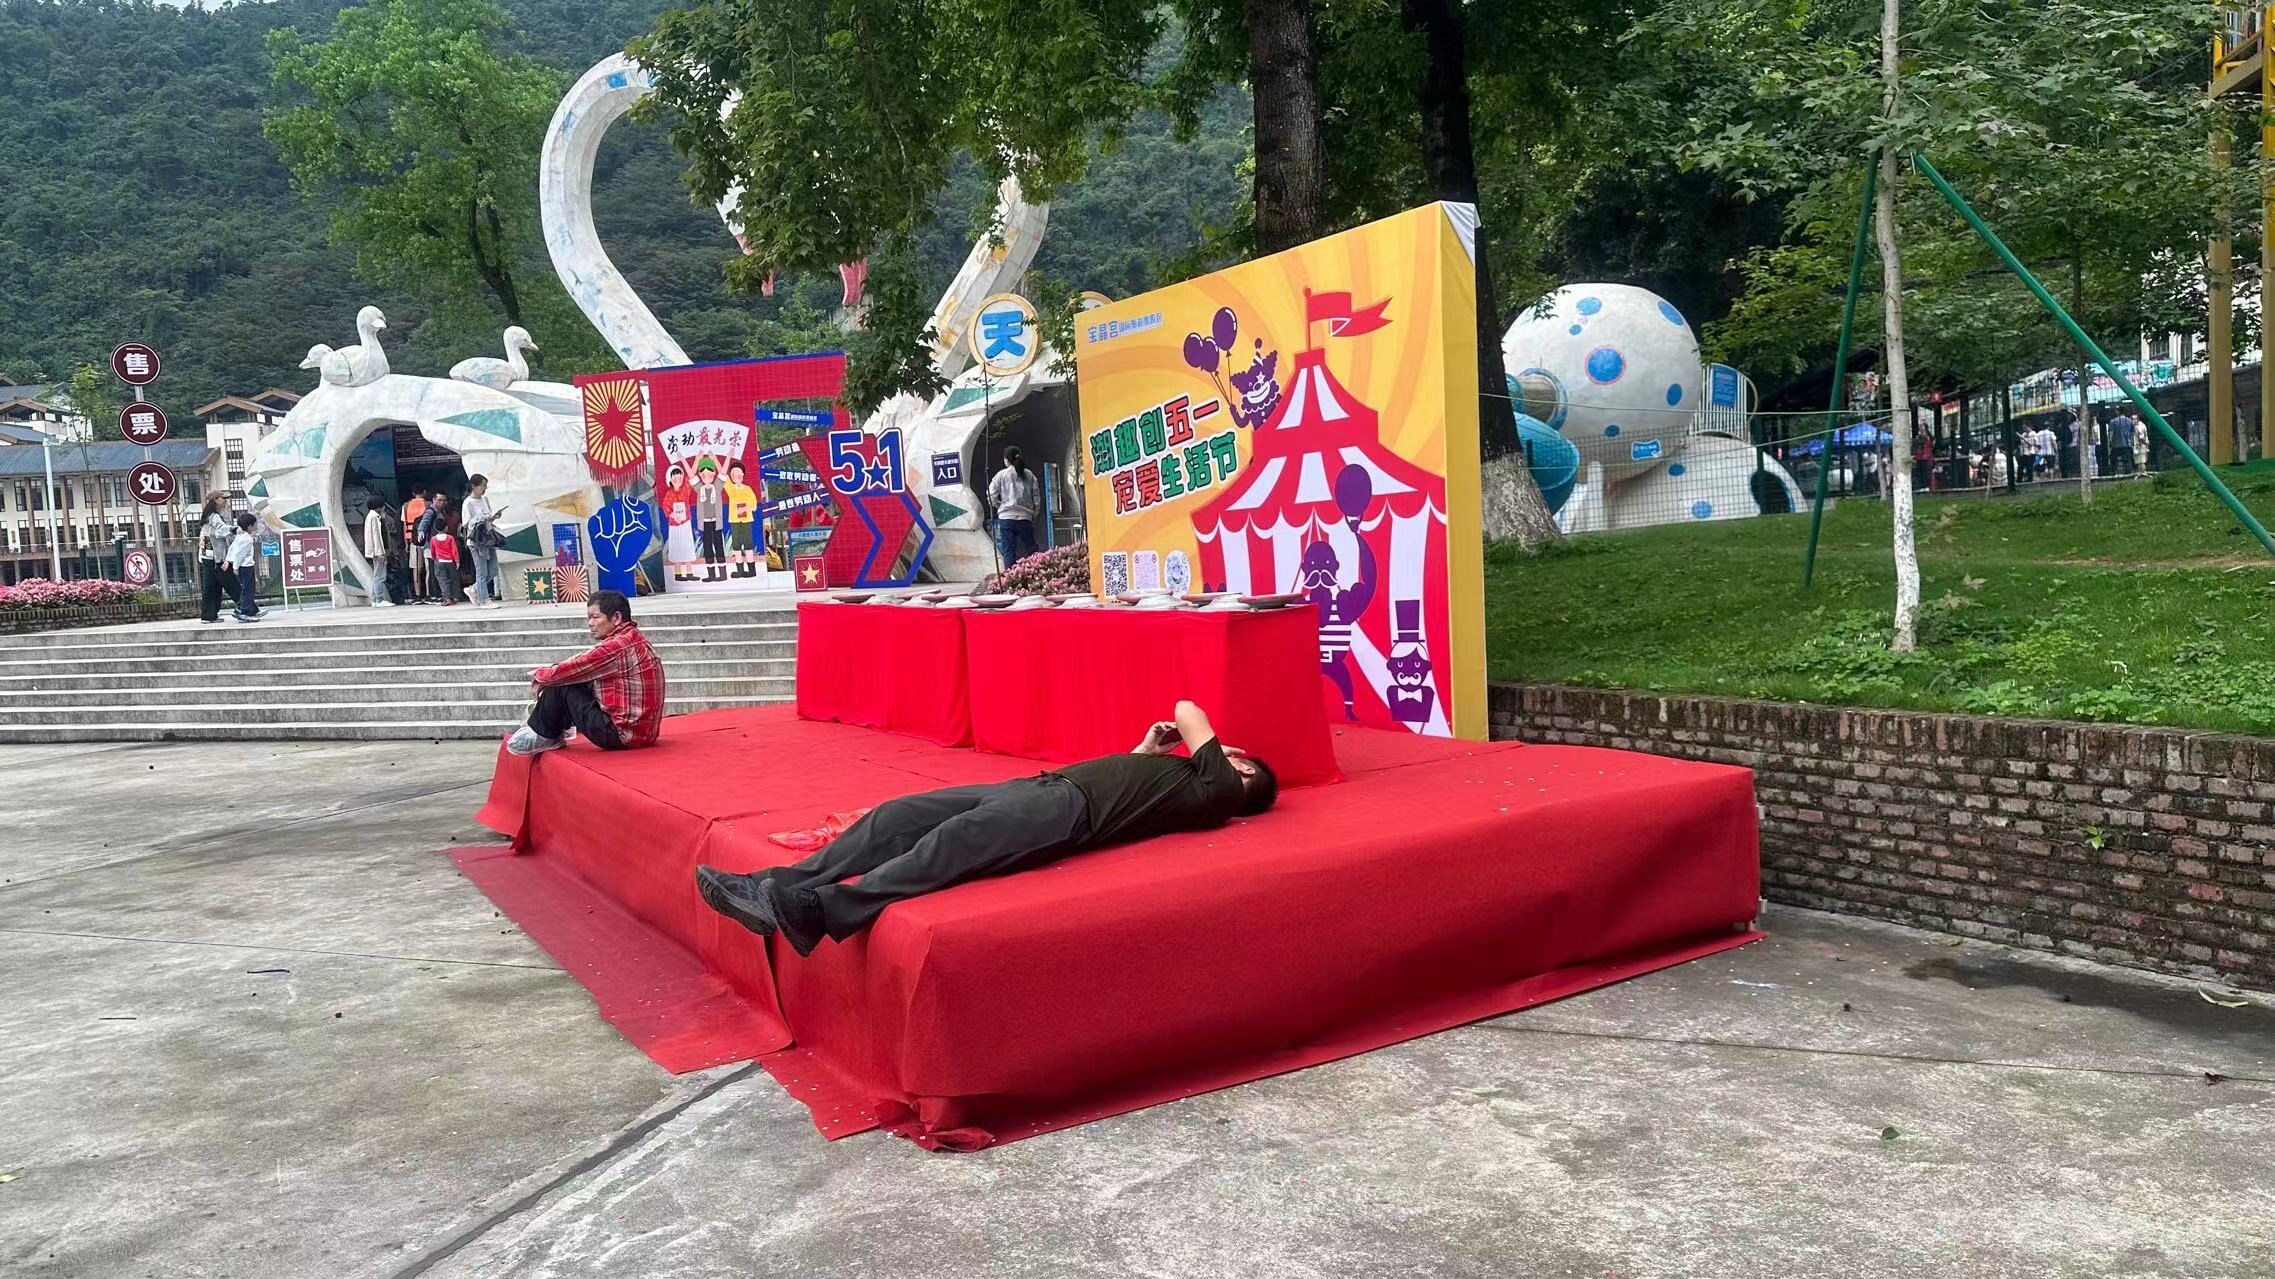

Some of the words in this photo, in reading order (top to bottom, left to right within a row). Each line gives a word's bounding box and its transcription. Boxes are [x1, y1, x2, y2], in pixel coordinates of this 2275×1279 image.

[982, 310, 1025, 359] 天
[667, 426, 742, 455] 劳动最光荣
[1089, 395, 1220, 476] 潮趣创五一
[937, 466, 957, 480] 入口
[1112, 432, 1238, 514] 宠爱生活节
[288, 539, 304, 581] 售票处
